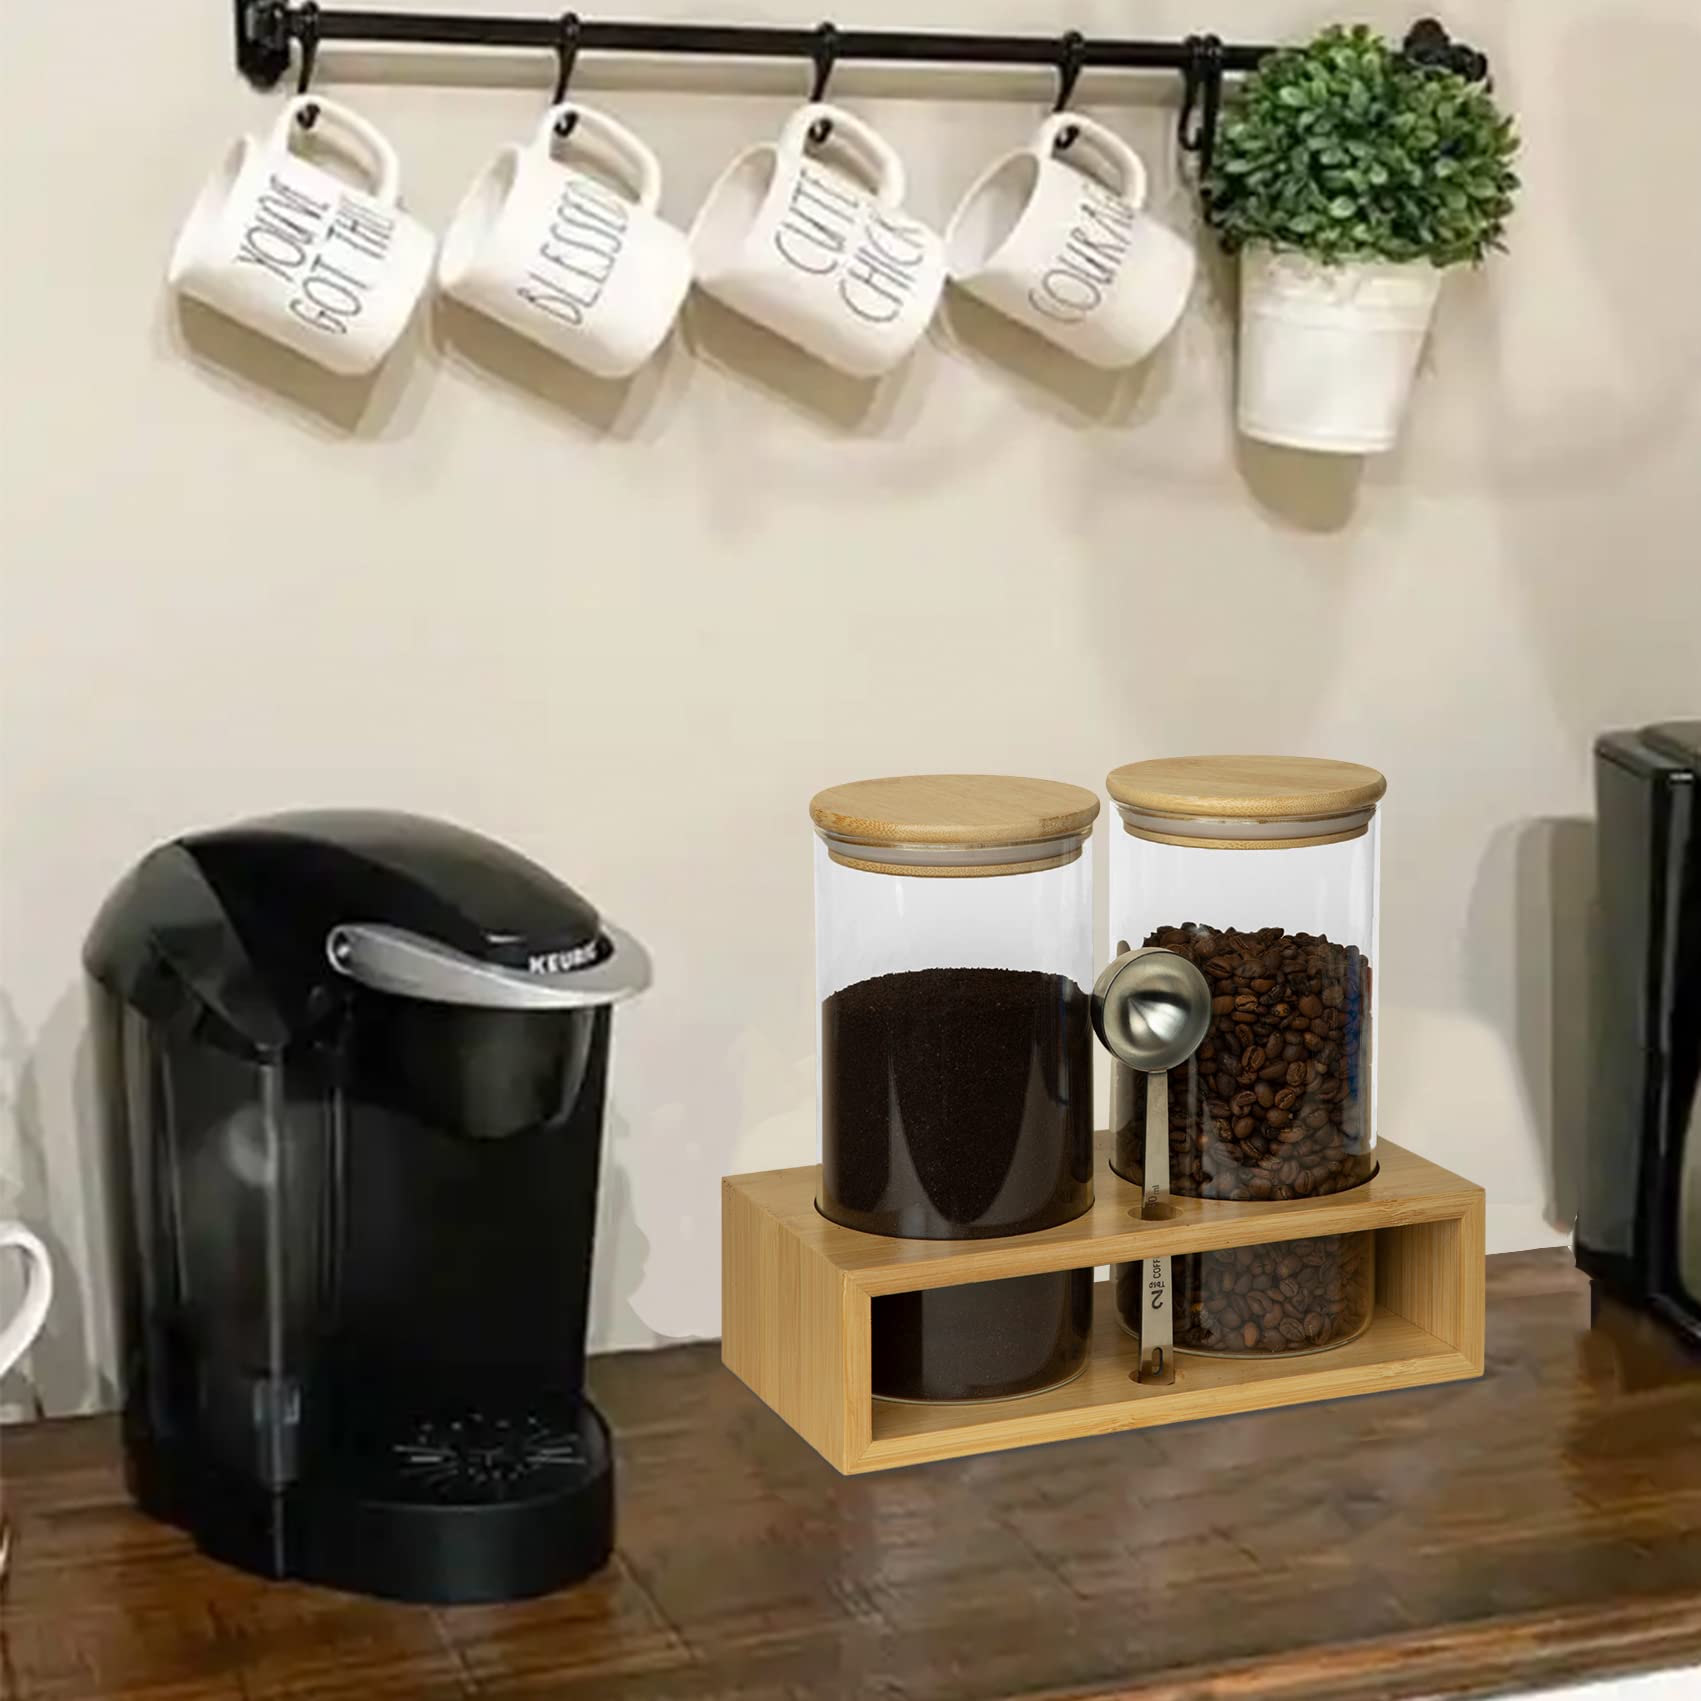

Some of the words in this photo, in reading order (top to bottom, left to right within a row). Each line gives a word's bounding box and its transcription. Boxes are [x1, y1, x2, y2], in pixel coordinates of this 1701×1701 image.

[775, 168, 860, 275] CUTE
[289, 253, 372, 334] GOT
[839, 204, 925, 323] CHICK
[1151, 1289, 1164, 1310] 2
[1152, 1255, 1162, 1279] COFF
